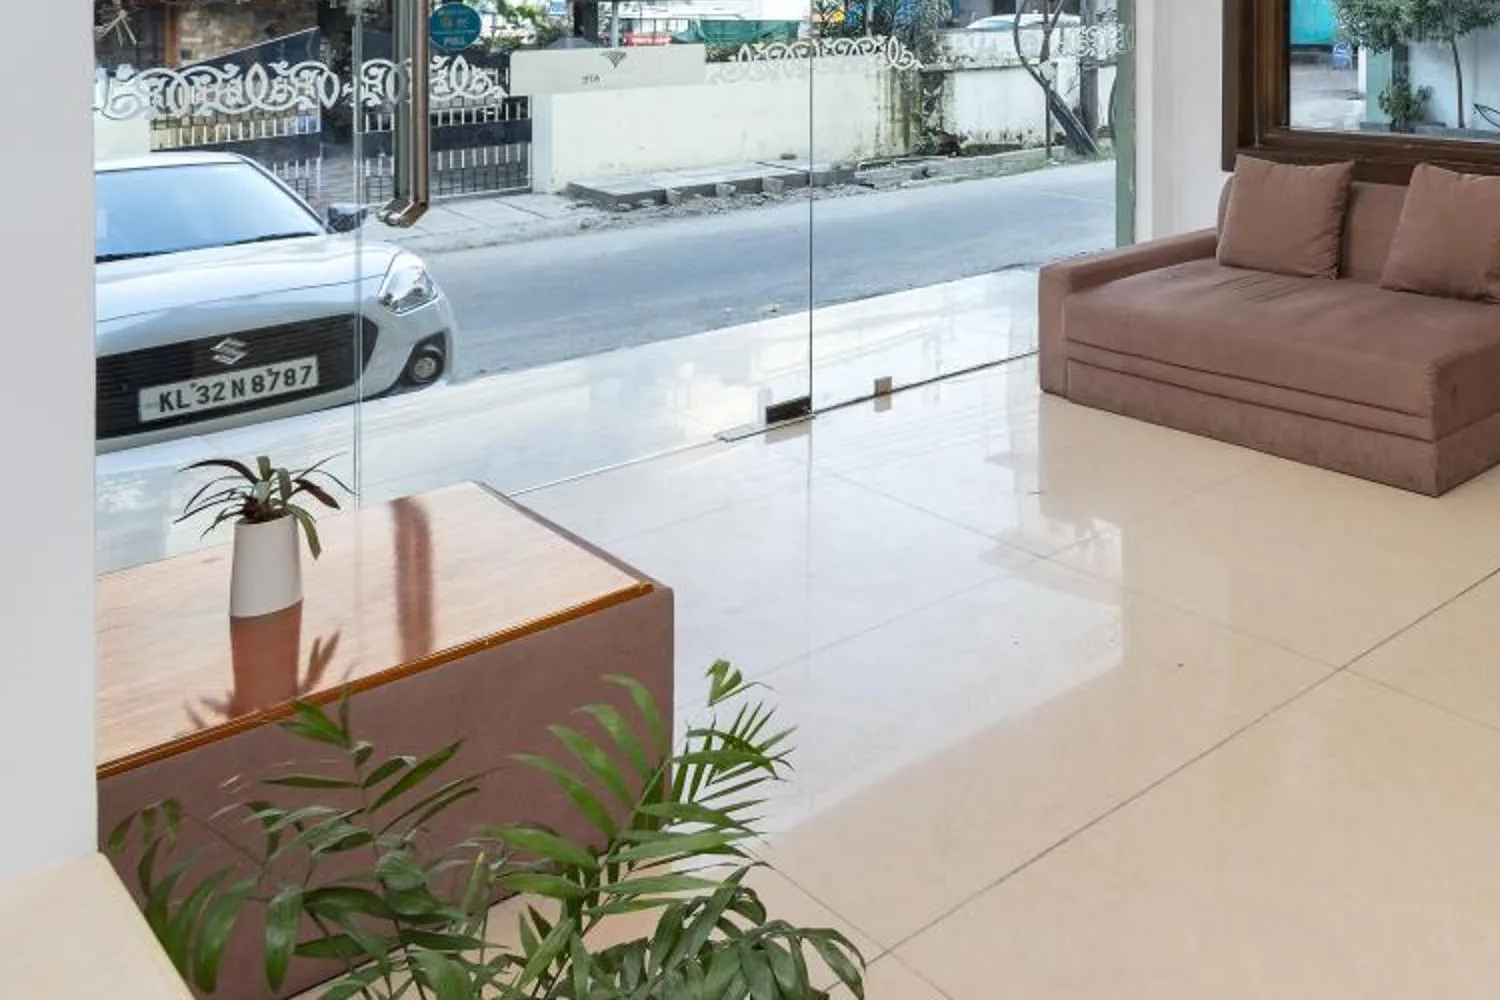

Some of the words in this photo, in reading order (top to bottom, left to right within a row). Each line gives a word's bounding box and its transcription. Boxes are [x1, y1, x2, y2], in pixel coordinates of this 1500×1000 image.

[159, 389, 191, 413] KL
[195, 382, 226, 404] 32
[231, 377, 245, 398] N
[251, 365, 313, 394] 8787
